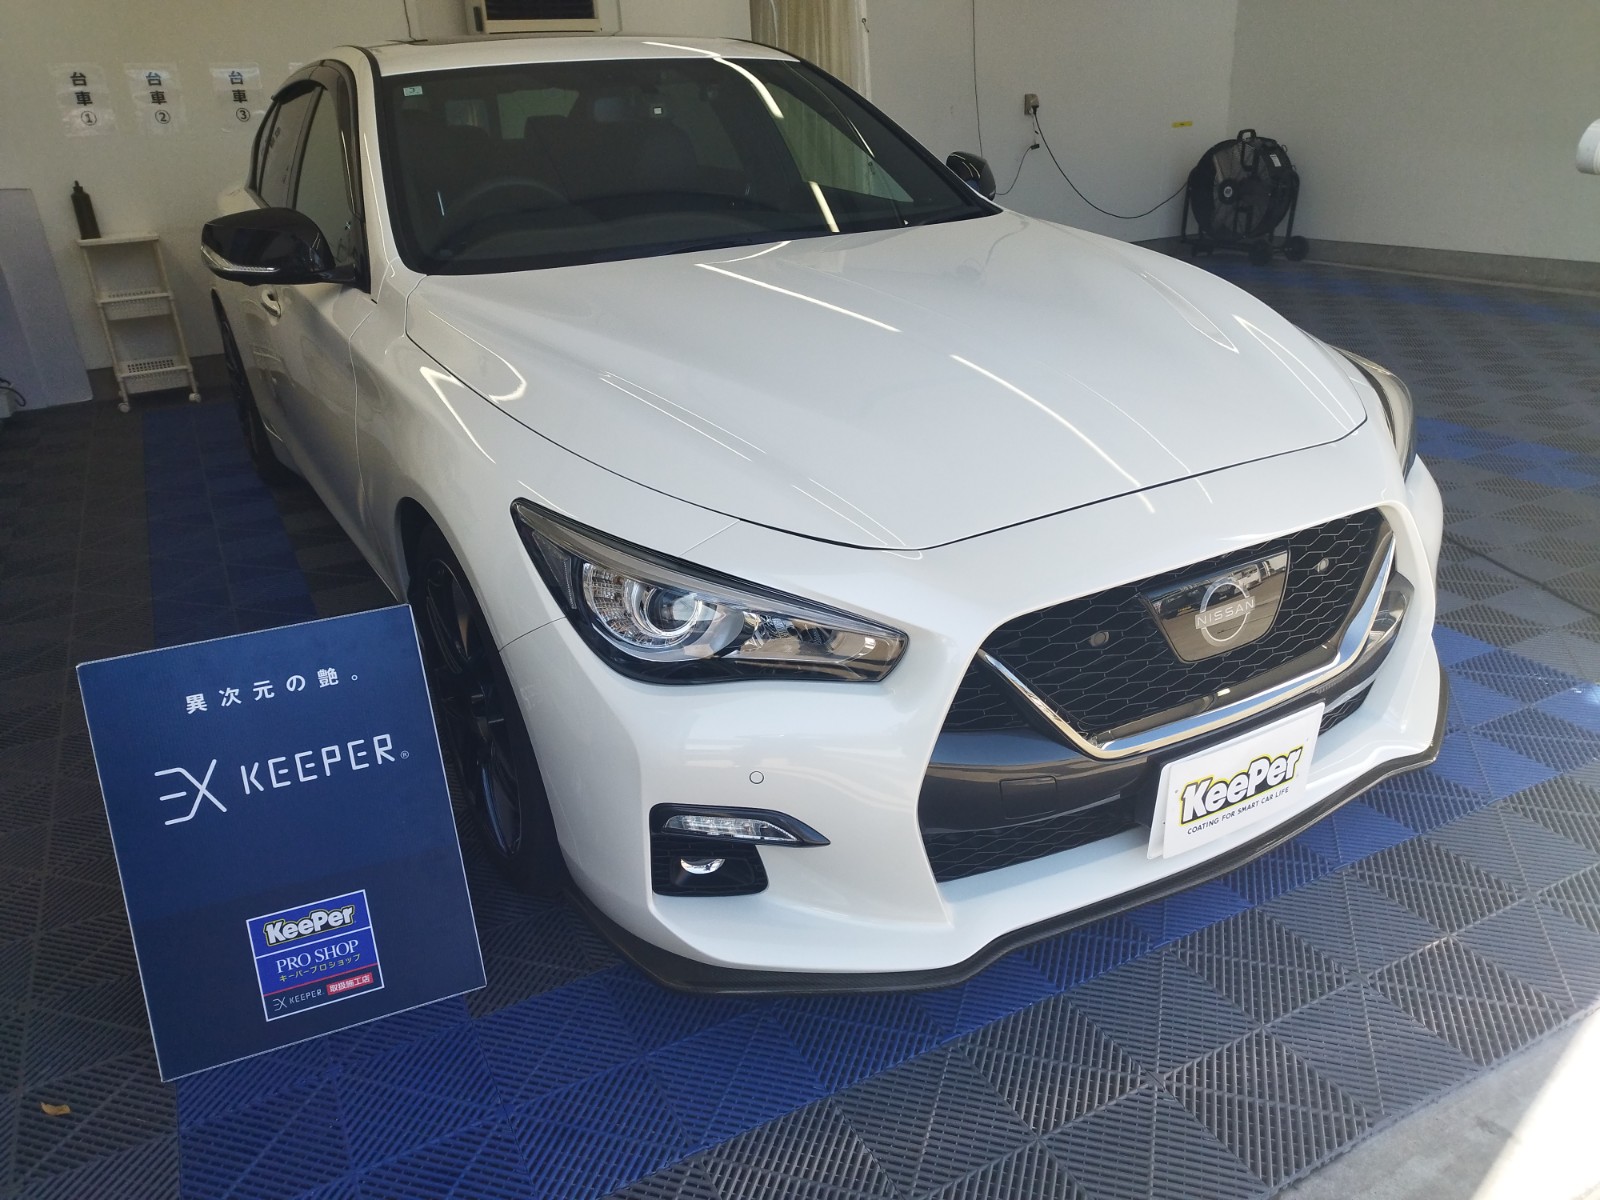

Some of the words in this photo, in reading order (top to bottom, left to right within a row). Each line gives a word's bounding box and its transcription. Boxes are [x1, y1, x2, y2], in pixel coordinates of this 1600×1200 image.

[1197, 599, 1254, 626] NISSAN
[1181, 746, 1303, 825] KeePer
[1187, 818, 1220, 835] COATING
[1221, 810, 1235, 822] FOR
[1237, 801, 1260, 815] SMART
[1261, 794, 1274, 804] CAR
[1275, 786, 1289, 798] LIFE
[264, 905, 355, 946] KeePer
[276, 952, 311, 974] PRO
[314, 939, 359, 963] SHOP
[279, 953, 361, 982] キーパープロショップ
[329, 974, 370, 993] 取扱施工店
